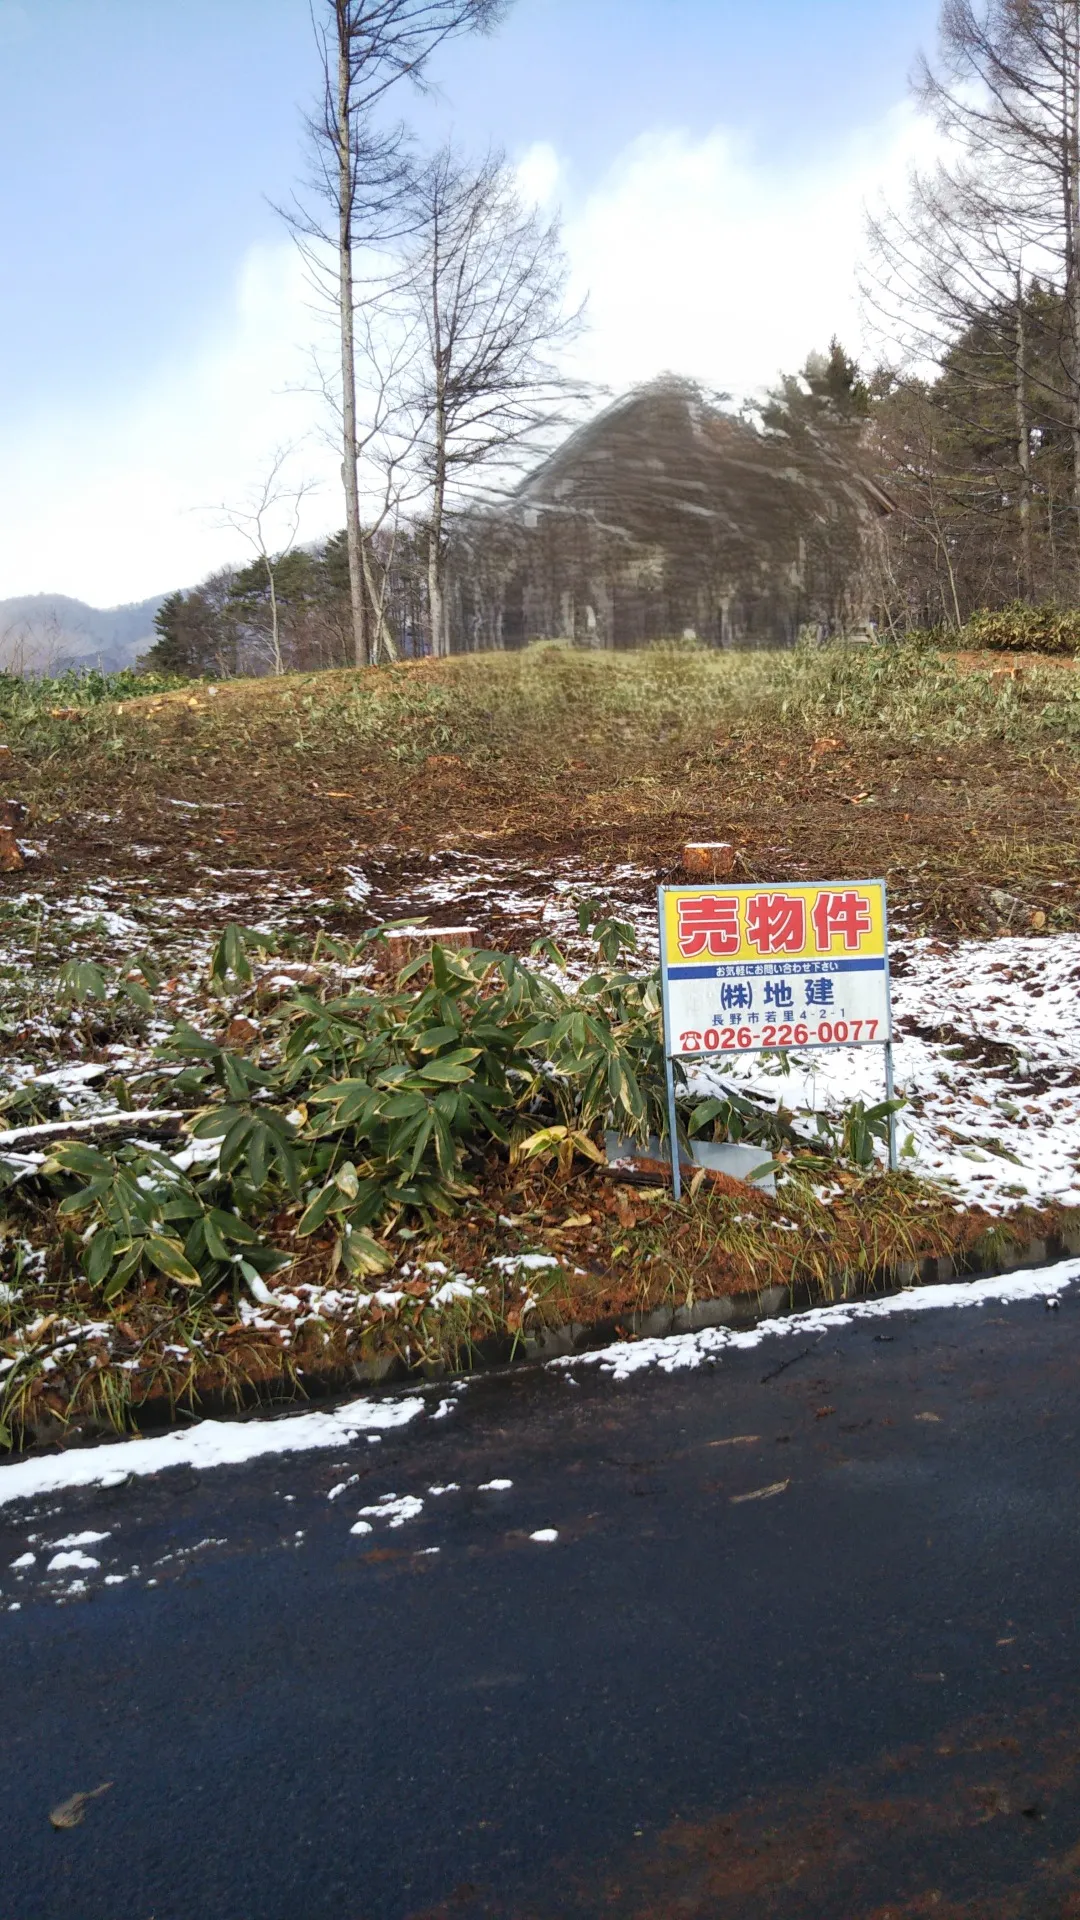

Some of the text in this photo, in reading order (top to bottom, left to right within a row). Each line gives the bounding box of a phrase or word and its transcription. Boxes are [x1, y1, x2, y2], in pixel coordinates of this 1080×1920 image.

[677, 890, 872, 958] 売物件
[716, 962, 838, 977] お気軽にお問い合わせ下さい
[712, 1008, 845, 1026] 長野市若里4-2-1
[704, 1020, 879, 1049] 026-226-0077
